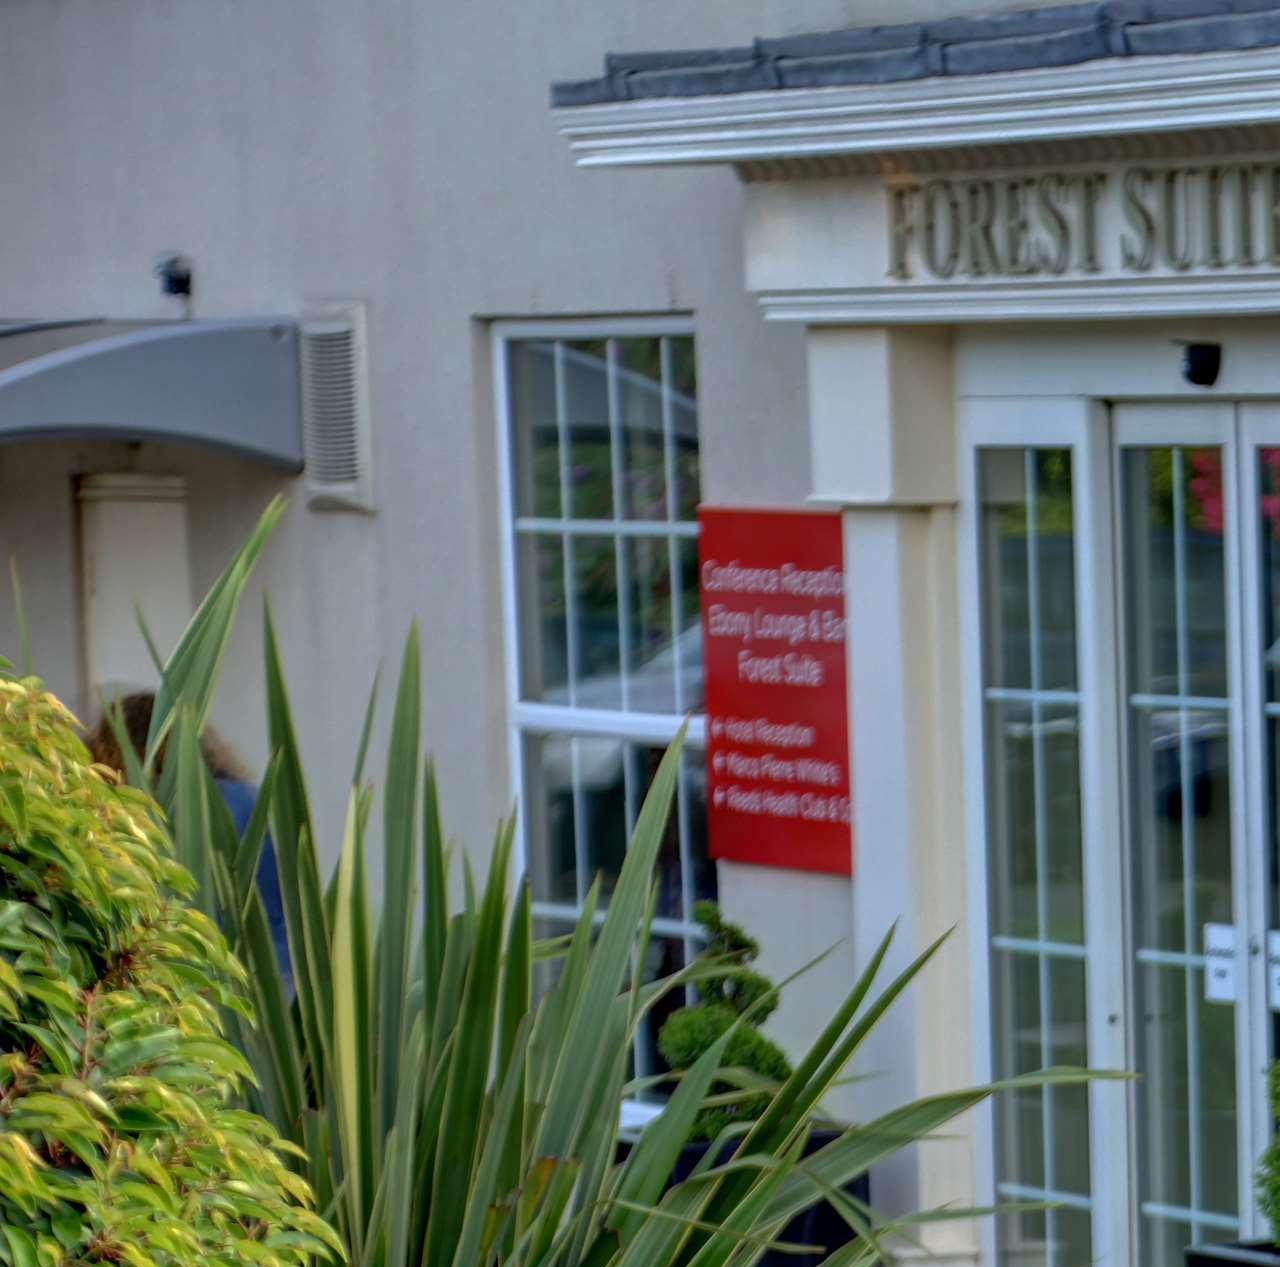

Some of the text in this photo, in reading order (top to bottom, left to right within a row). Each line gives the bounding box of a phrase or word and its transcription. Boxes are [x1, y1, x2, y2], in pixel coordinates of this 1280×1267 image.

[884, 171, 1107, 280] FOREST
[702, 560, 844, 600] Conference Receptio
[753, 607, 807, 646] Lounge
[737, 650, 825, 687] Forest Suite
